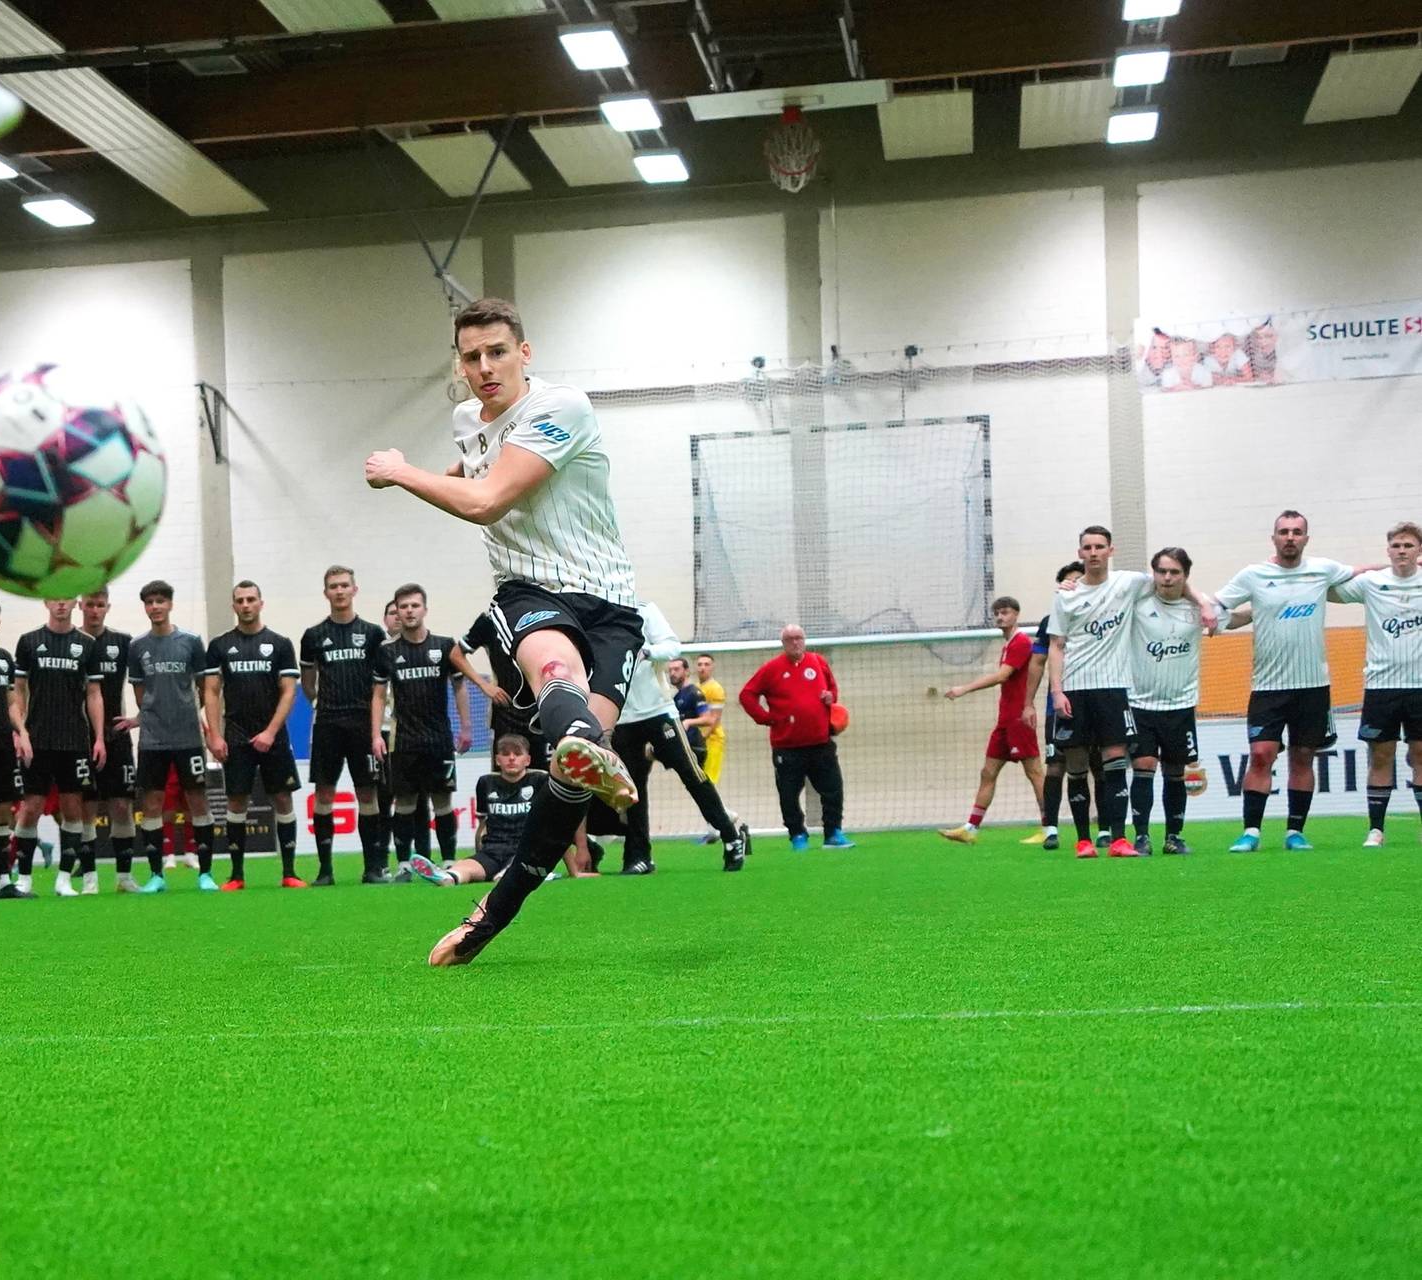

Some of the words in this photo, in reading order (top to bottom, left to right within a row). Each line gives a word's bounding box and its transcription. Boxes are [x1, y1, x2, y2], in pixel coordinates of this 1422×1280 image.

[1306, 318, 1399, 341] SCHULTE
[477, 432, 488, 455] 8
[1083, 610, 1125, 641] Grote
[325, 648, 367, 662] VELTINS
[1146, 639, 1191, 662] Grote
[37, 656, 79, 671] VELTINS
[229, 660, 272, 673] VELTINS
[396, 665, 441, 680] VELTINS
[1185, 731, 1195, 750] 3
[189, 755, 205, 776] 8
[443, 759, 456, 780] 7
[488, 801, 532, 815] VELTINS
